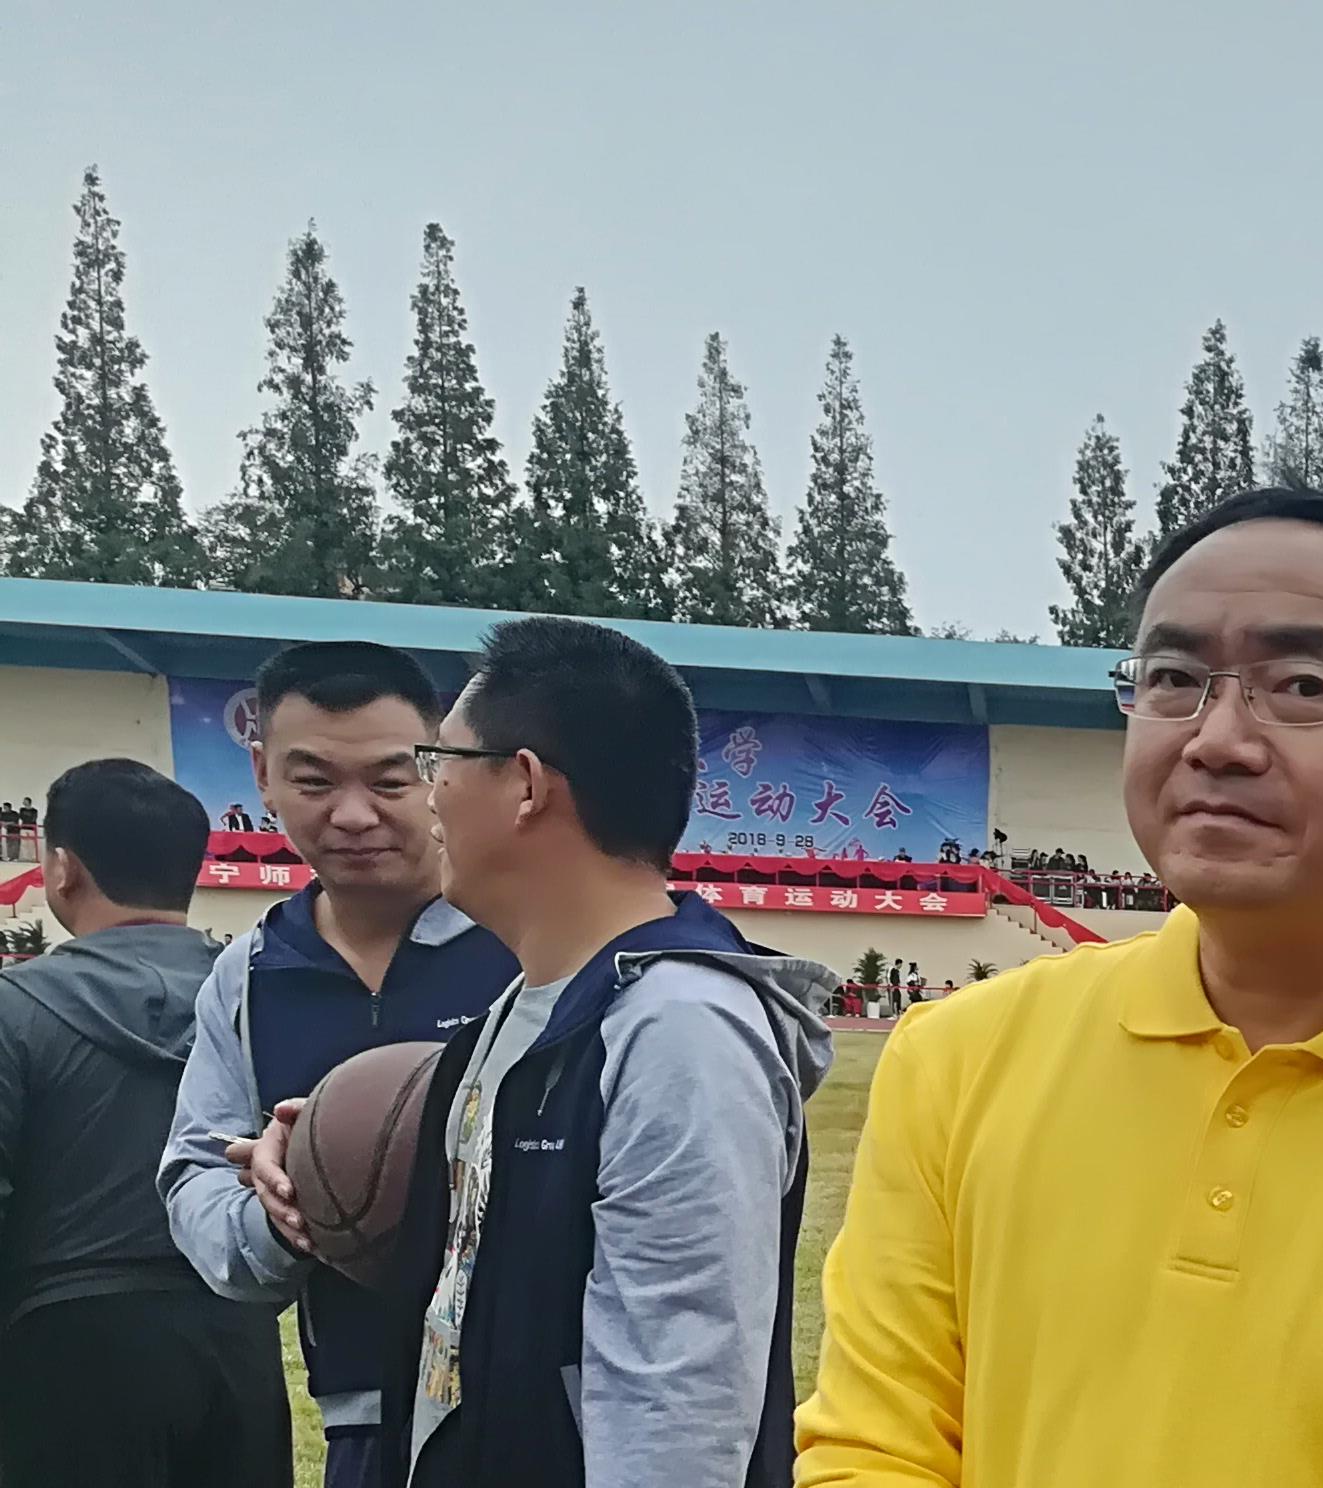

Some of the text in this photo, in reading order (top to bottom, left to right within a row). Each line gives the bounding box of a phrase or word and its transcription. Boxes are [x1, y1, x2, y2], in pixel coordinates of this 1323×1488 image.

[696, 780, 913, 829] 运动大会
[728, 832, 814, 848] 2018-9-28
[209, 863, 948, 912] 宁师 体育运动大会
